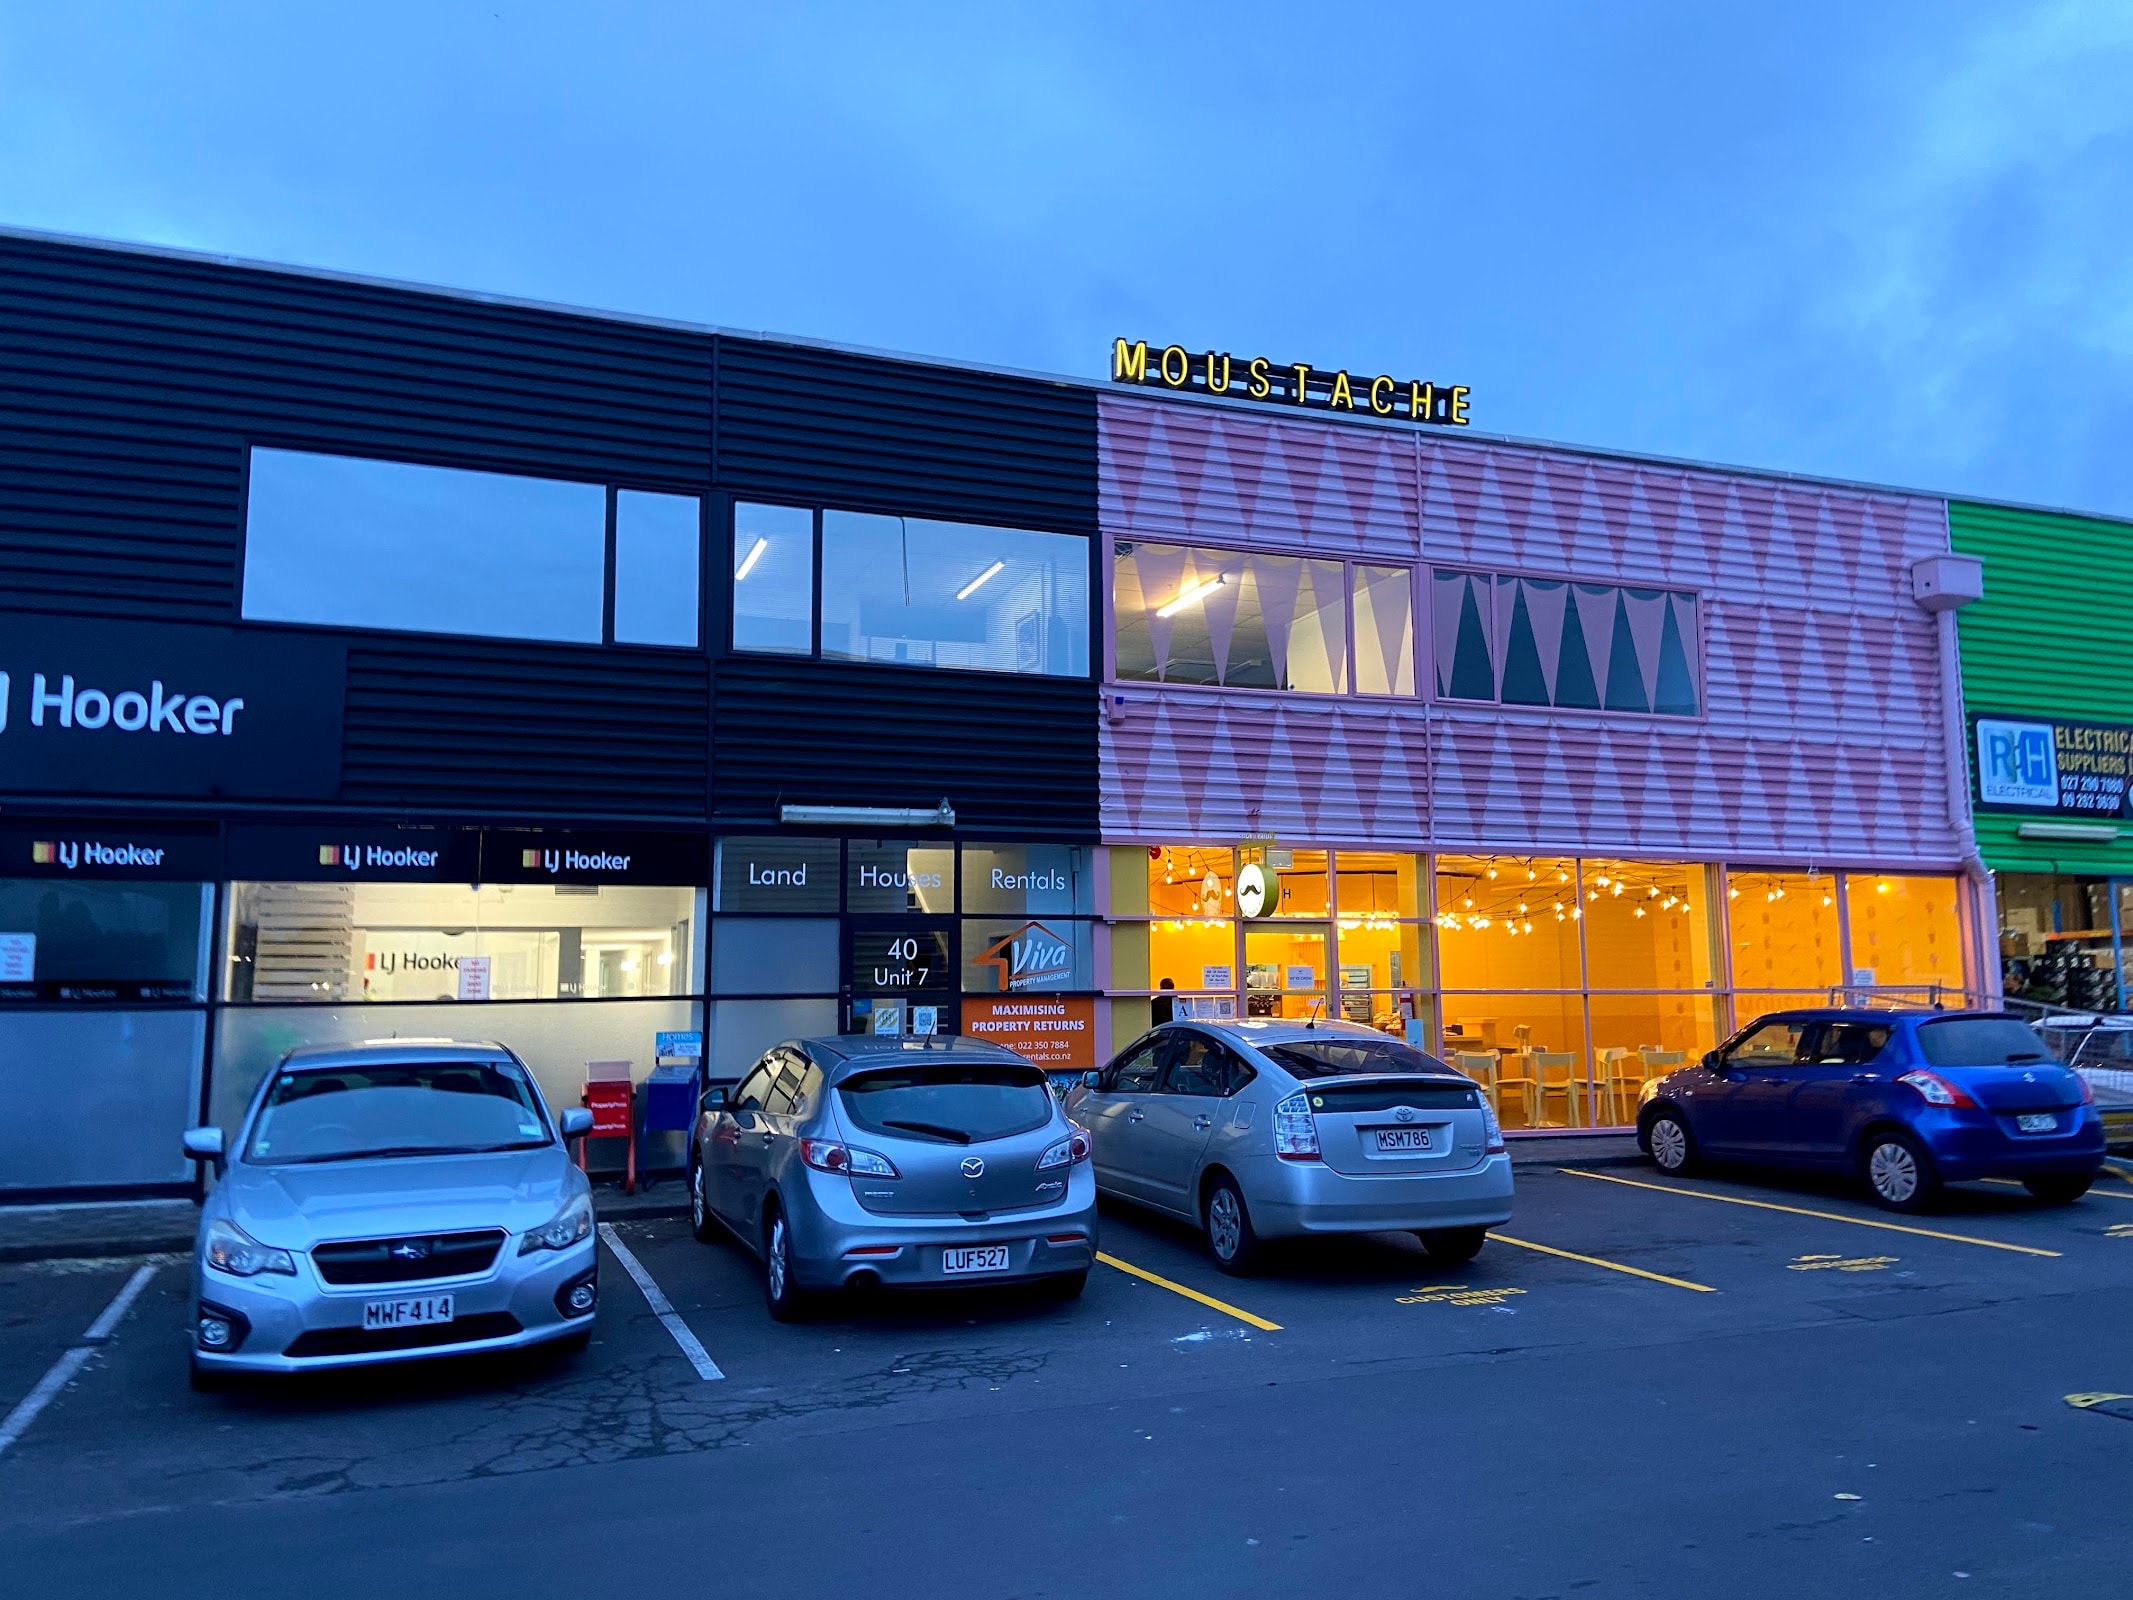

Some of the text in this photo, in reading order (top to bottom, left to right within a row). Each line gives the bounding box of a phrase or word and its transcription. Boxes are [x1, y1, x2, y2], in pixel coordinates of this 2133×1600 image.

[1114, 337, 1470, 425] MOUSTACHE
[31, 673, 244, 735] Hooker
[2057, 751, 2126, 774] SUPPLIERS
[59, 841, 165, 869] LJ Hooker
[344, 844, 439, 871] LJ Hooker
[544, 848, 631, 874] LJ Hooker
[749, 862, 807, 887] Land
[859, 865, 942, 889] Houses
[990, 868, 1066, 891] Rentals
[887, 938, 918, 961] 40
[1013, 939, 1067, 975] Viva
[380, 952, 462, 975] LJ Hooke
[873, 967, 929, 986] Unit 7
[1009, 971, 1071, 988] PROPERTY MANAGEMENT
[992, 1004, 1065, 1016] MAXIMISING
[1178, 1004, 1188, 1017] A
[972, 1019, 1085, 1032] PROPERTY RETURNS
[1018, 1041, 1032, 1050] 022
[1034, 1041, 1049, 1050] 350
[1050, 1040, 1069, 1049] 7884
[1021, 1052, 1072, 1061] rentals.co.nz
[1378, 1131, 1430, 1147] MSM786
[945, 1248, 1006, 1270] LUF527
[1394, 1287, 1528, 1304] CUSTOMERS
[366, 1298, 450, 1325] MWF414
